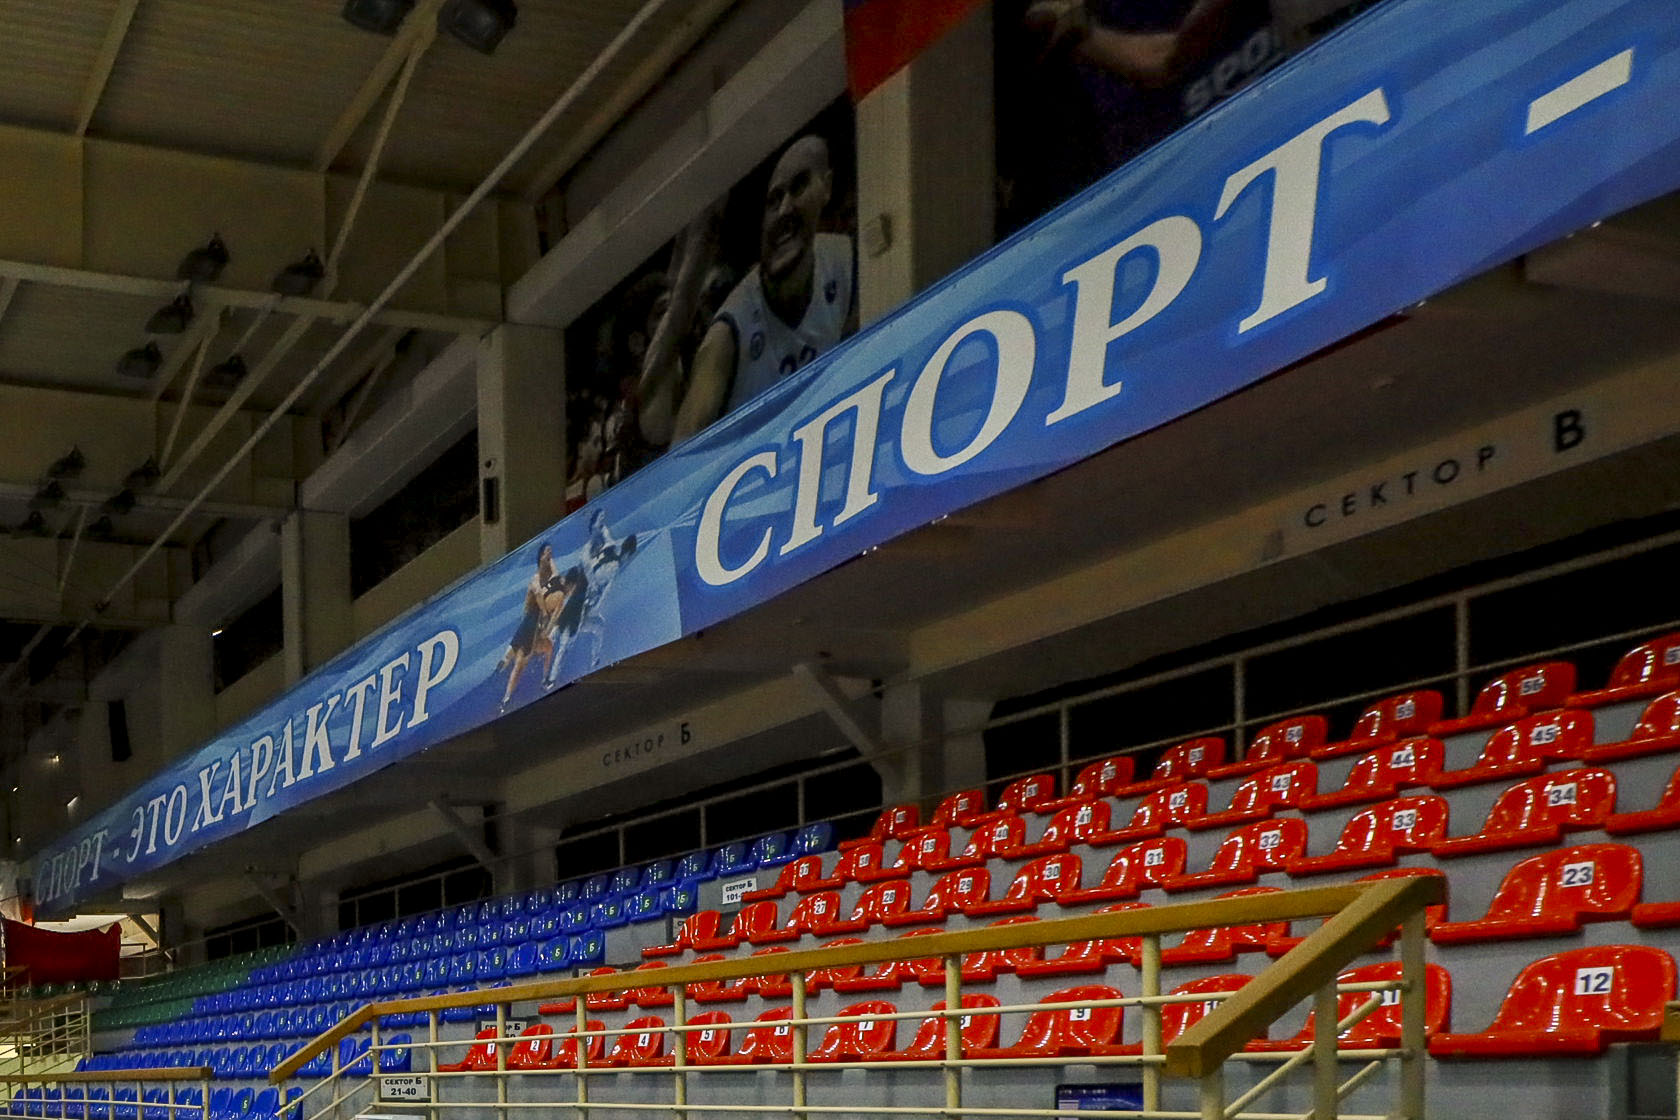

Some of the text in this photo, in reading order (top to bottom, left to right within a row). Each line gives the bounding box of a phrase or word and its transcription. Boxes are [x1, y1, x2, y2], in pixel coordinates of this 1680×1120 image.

[695, 87, 1391, 586] СПОРТ
[1304, 408, 1586, 528] СЕКТОР В
[1531, 726, 1556, 742] 45
[602, 721, 691, 767] СЕКТОР Б
[1392, 752, 1414, 767] 44
[36, 828, 109, 906] СПОРТ
[126, 784, 188, 863] ЭТО
[191, 629, 460, 833] ХАРАКТЕР
[1273, 774, 1290, 789] 43
[1170, 794, 1186, 807] 42
[1550, 786, 1576, 803] 34
[1393, 812, 1416, 829] 33
[995, 827, 1008, 840] 40
[1260, 832, 1280, 848] 32
[1146, 850, 1163, 865] 31
[1045, 864, 1061, 879] 30
[1563, 866, 1593, 885] 23
[725, 882, 747, 892] СЕКТОР
[815, 901, 826, 914] 27
[1579, 972, 1610, 993] 12
[415, 1076, 422, 1085] Б
[390, 1087, 416, 1096] 21-40
